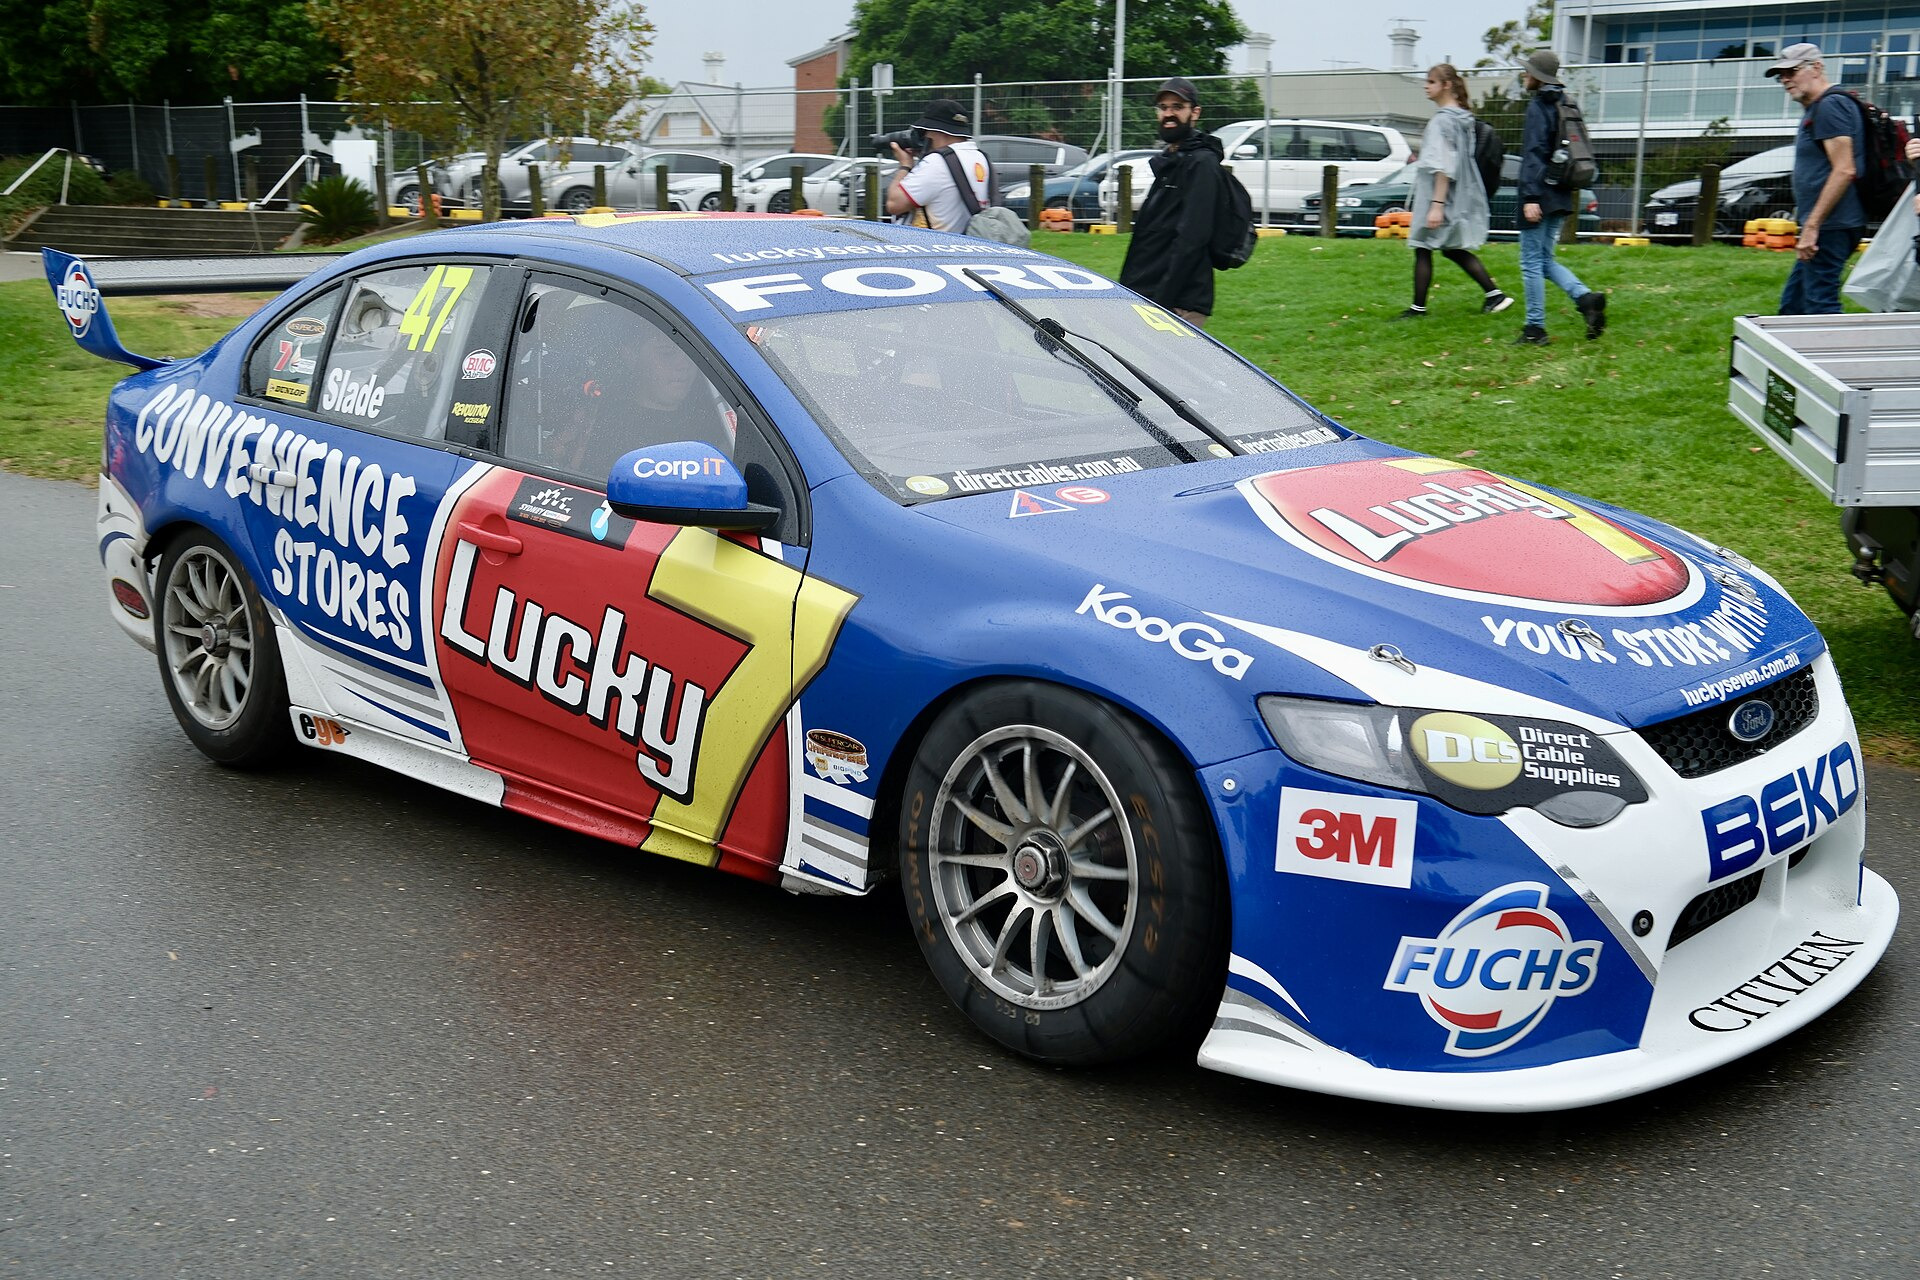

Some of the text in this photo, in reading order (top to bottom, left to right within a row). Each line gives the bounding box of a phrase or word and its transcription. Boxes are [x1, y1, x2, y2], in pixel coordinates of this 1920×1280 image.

[711, 241, 1040, 264] luckyseven.com.au
[59, 288, 98, 312] FUCHS
[399, 264, 474, 353] 47
[703, 264, 1117, 312] FORD
[1130, 303, 1197, 338] 47
[466, 357, 494, 372] BMC
[274, 385, 306, 397] DUNLOP
[322, 367, 385, 419] Slade
[452, 402, 492, 418] REVOLUTION
[135, 383, 417, 569] CONVENIENCE
[953, 456, 1144, 492] directcables.com.au
[1309, 482, 1575, 562] Lucky
[272, 528, 413, 652] STORES
[1074, 583, 1255, 681] KooGa
[1611, 621, 1731, 668] STORE
[440, 526, 864, 871] Lucky 7
[1679, 652, 1801, 707] luckyseven.com.au
[1518, 726, 1592, 749] Direct
[1741, 708, 1766, 734] Ford
[1423, 728, 1521, 764] DCS
[1522, 743, 1585, 766] Cable
[1524, 761, 1621, 788] Supplies
[1700, 741, 1859, 884] BEKO
[1295, 807, 1397, 869] 3M
[908, 789, 937, 944] KUMHO
[1393, 943, 1596, 992] FUCHS
[1687, 930, 1865, 1033] CITIZEN
